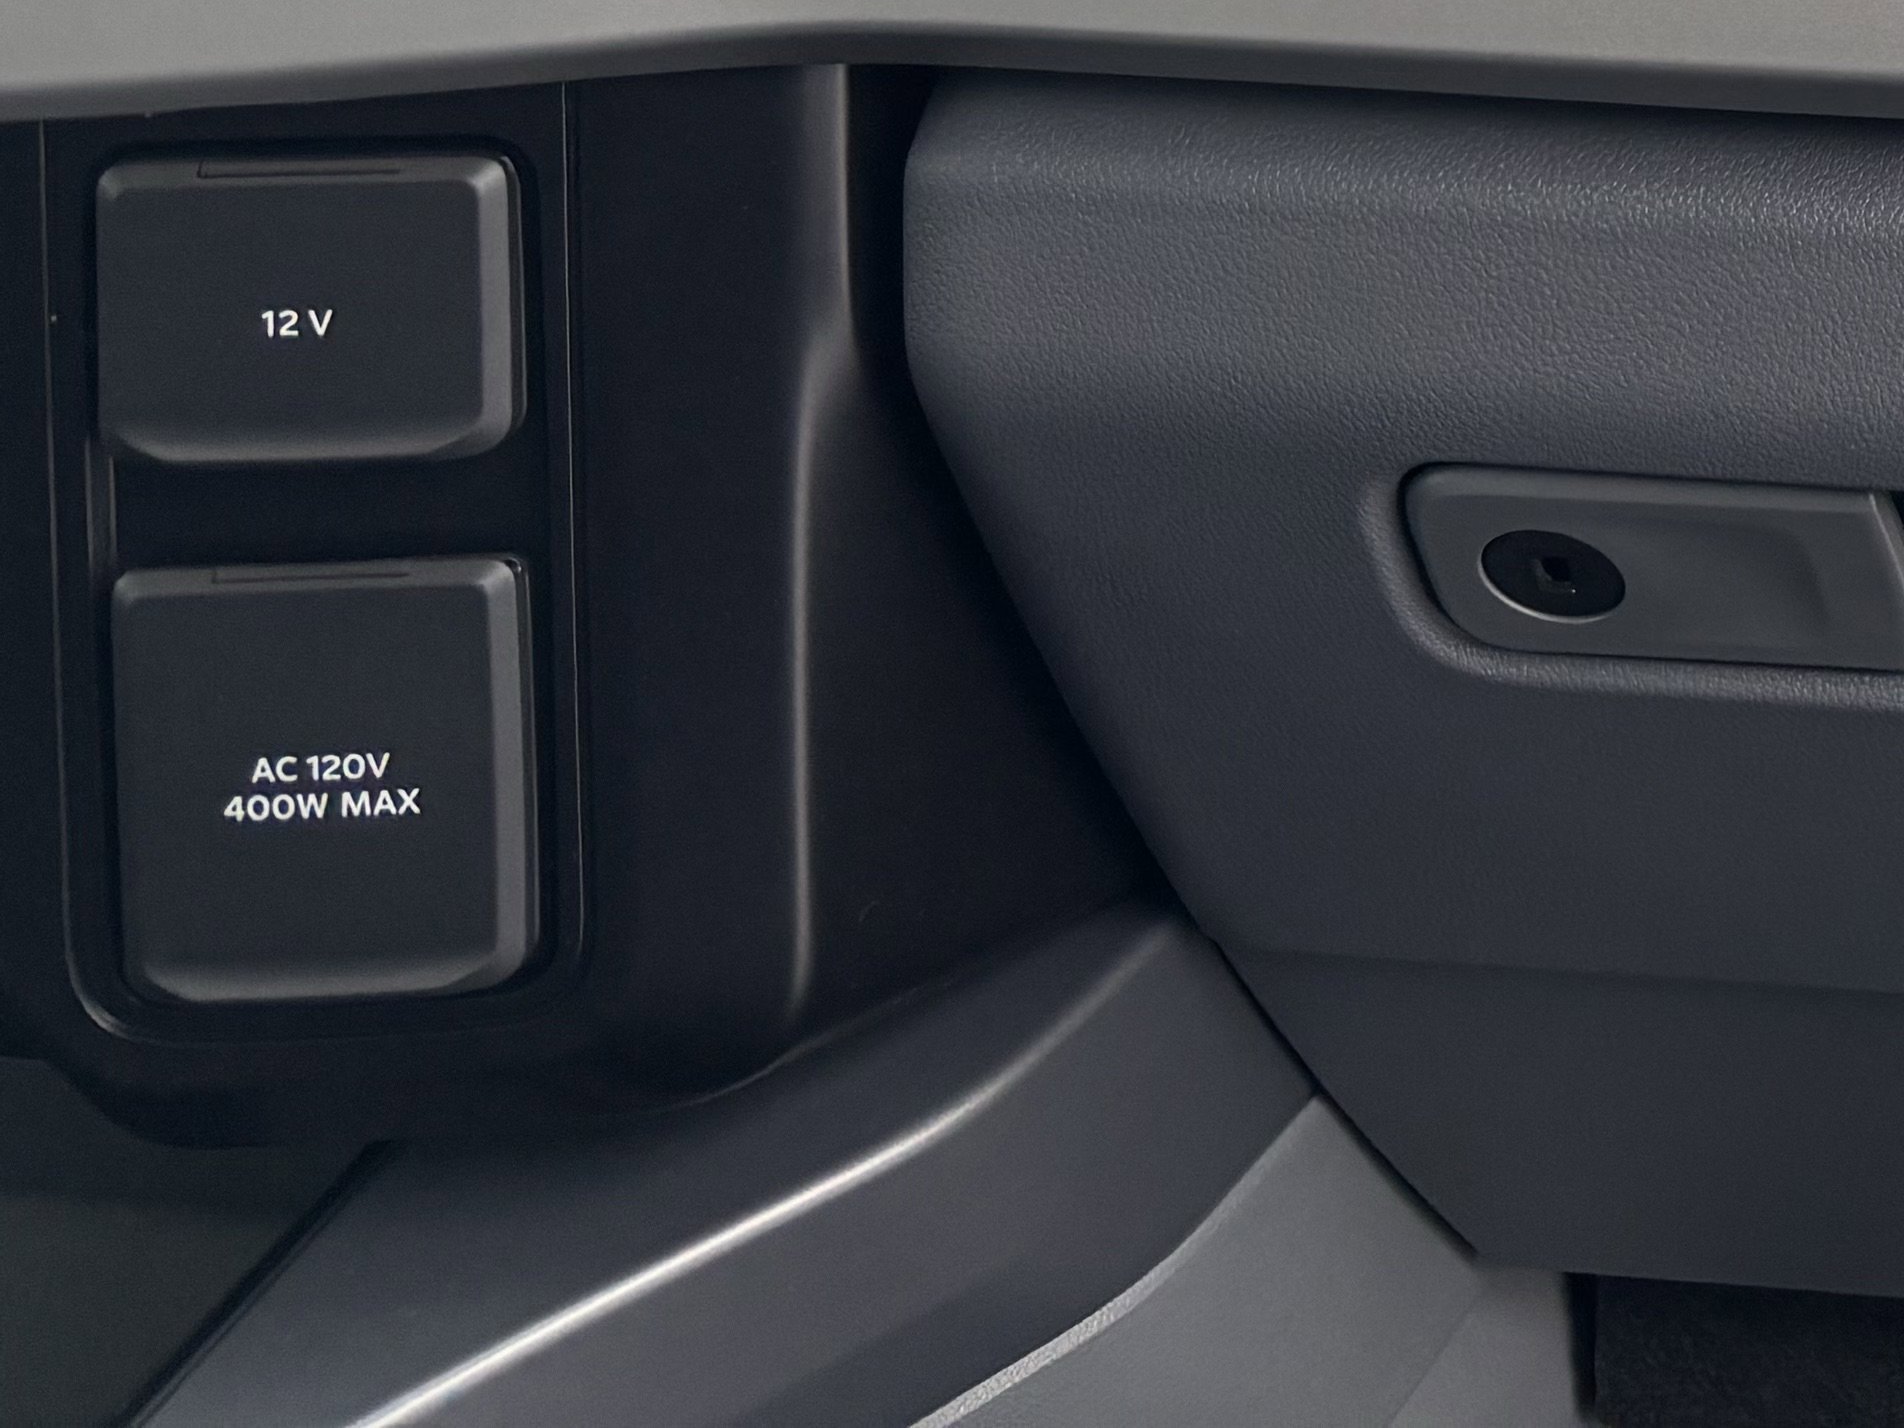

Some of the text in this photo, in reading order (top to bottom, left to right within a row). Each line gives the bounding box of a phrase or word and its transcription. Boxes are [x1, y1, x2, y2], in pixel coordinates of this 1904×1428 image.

[260, 309, 334, 338] 12 V
[251, 752, 391, 783] AC 120V
[223, 788, 422, 821] 400W MAX
